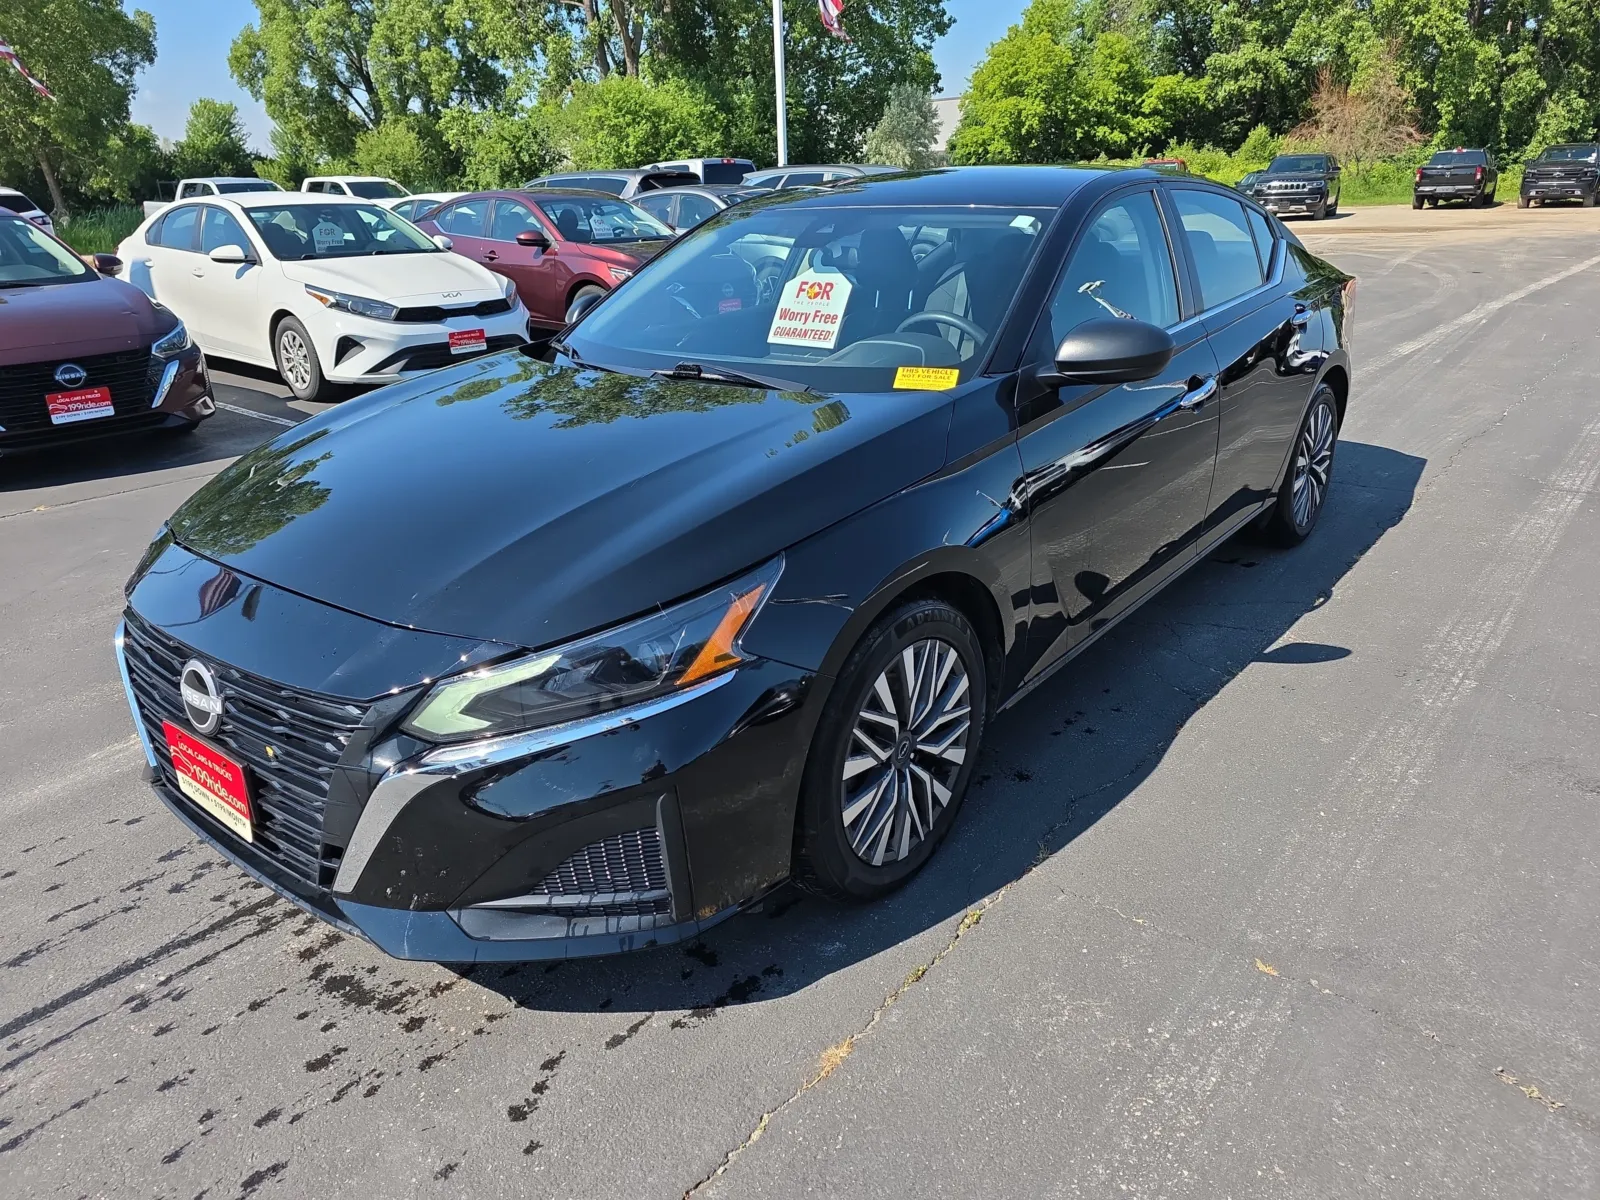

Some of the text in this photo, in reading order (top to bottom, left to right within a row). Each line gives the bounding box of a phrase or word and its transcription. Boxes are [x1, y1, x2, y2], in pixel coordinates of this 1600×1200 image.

[796, 281, 834, 300] FOR
[779, 307, 838, 325] Worry Free
[773, 326, 835, 341] GUARANTEED!
[55, 371, 87, 380] NISSAN
[921, 368, 954, 376] VEHICLE
[68, 400, 112, 411] 199ride.com
[178, 741, 195, 757] LOCAL
[195, 752, 208, 767] CARS
[212, 764, 233, 781] TRUCKS
[192, 765, 247, 814] 199ride.com
